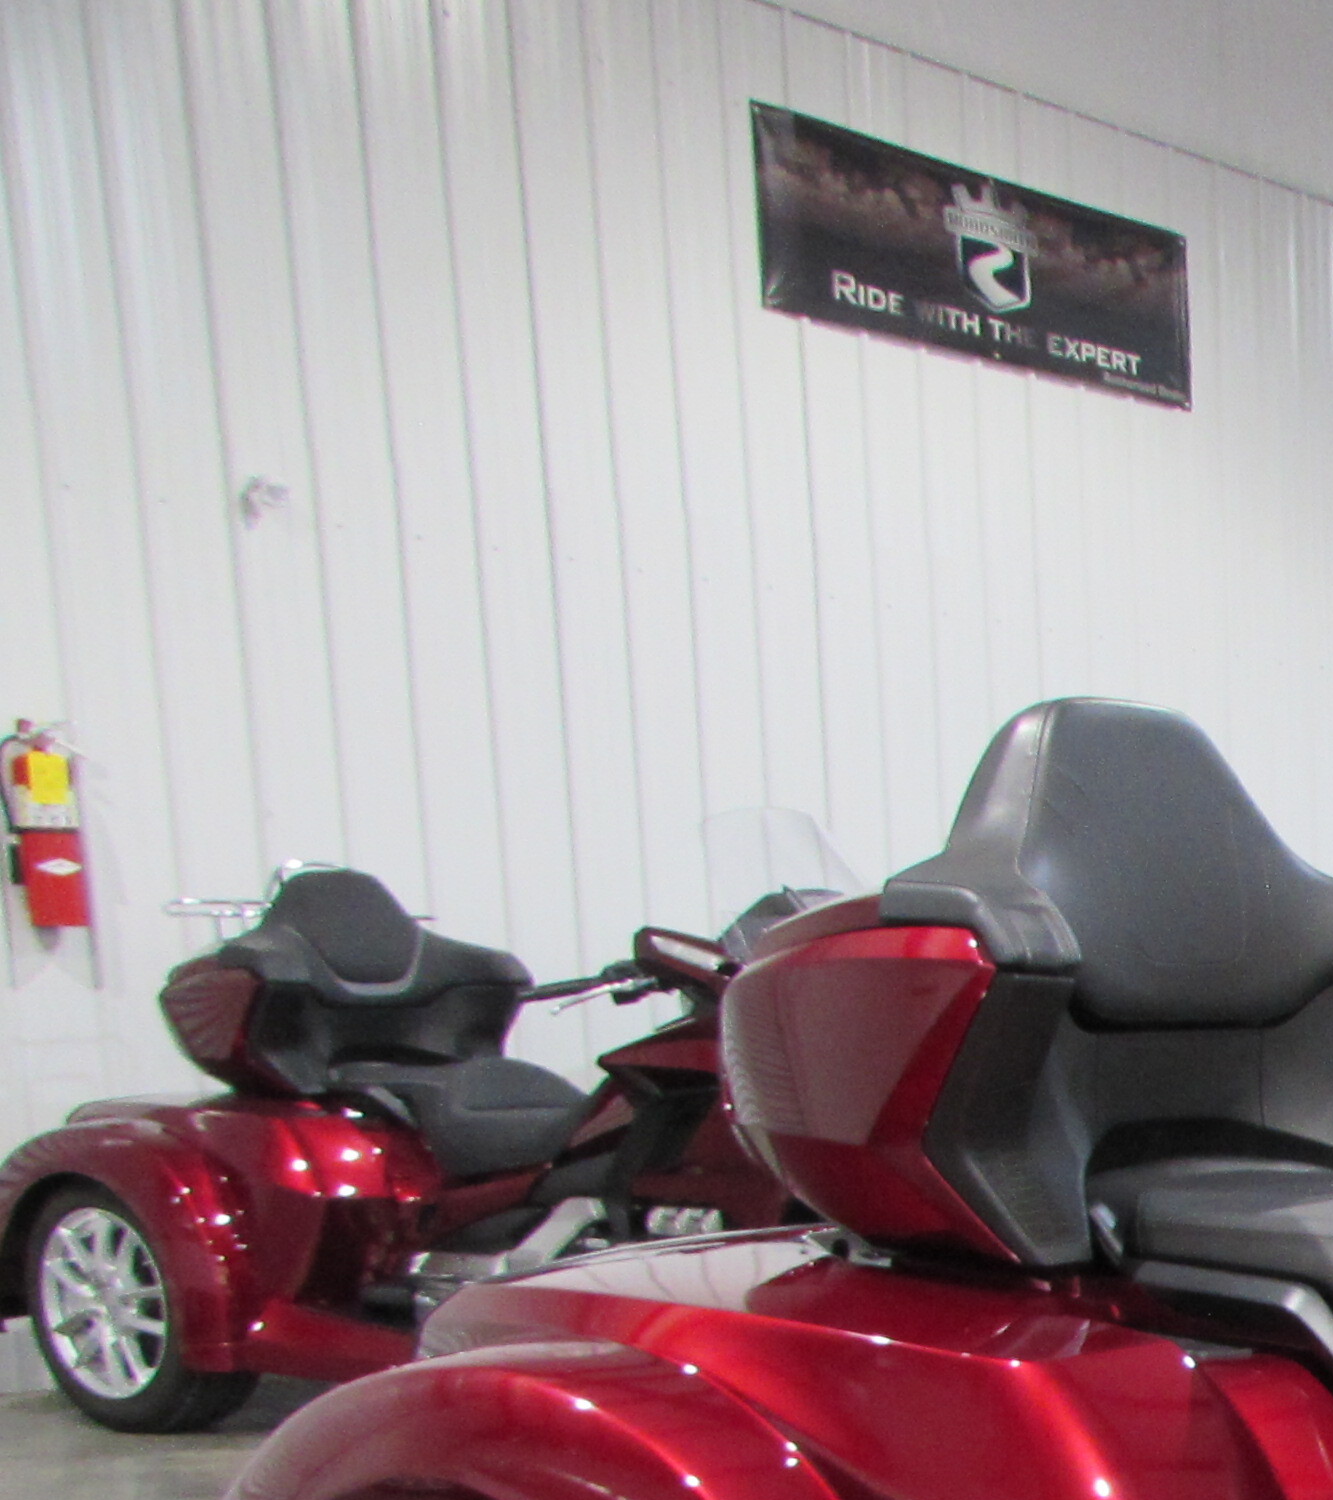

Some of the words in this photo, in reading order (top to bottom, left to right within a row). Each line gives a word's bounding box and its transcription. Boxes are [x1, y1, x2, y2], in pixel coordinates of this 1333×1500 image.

[831, 269, 905, 317] RIDE
[914, 300, 982, 337] WITH
[987, 315, 1039, 350] THE
[1047, 331, 1142, 376] EXPERT
